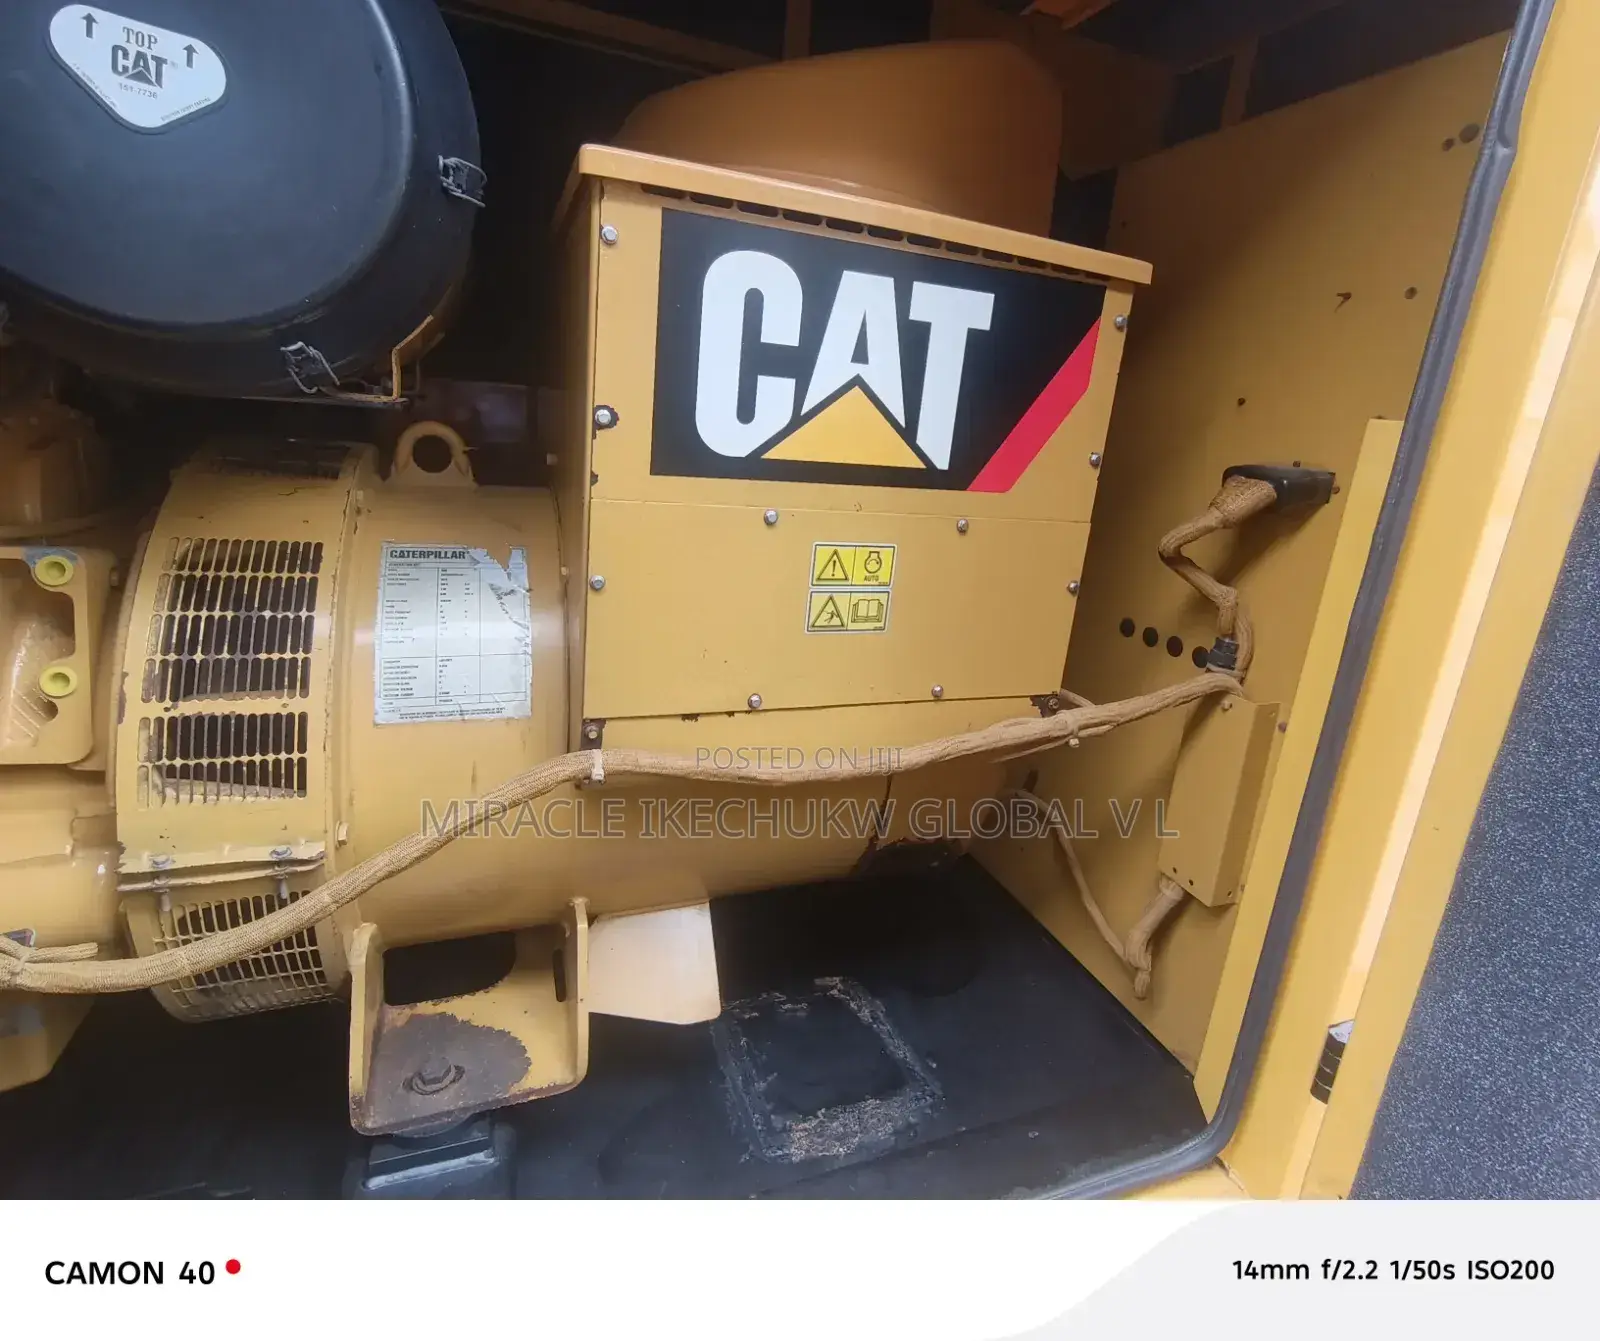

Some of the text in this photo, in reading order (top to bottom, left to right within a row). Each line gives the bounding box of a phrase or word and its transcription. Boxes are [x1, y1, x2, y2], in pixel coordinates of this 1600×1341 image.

[122, 26, 158, 51] TOP
[111, 44, 168, 89] CAT
[695, 250, 995, 470] CAT
[389, 549, 466, 560] CATERPILLAR
